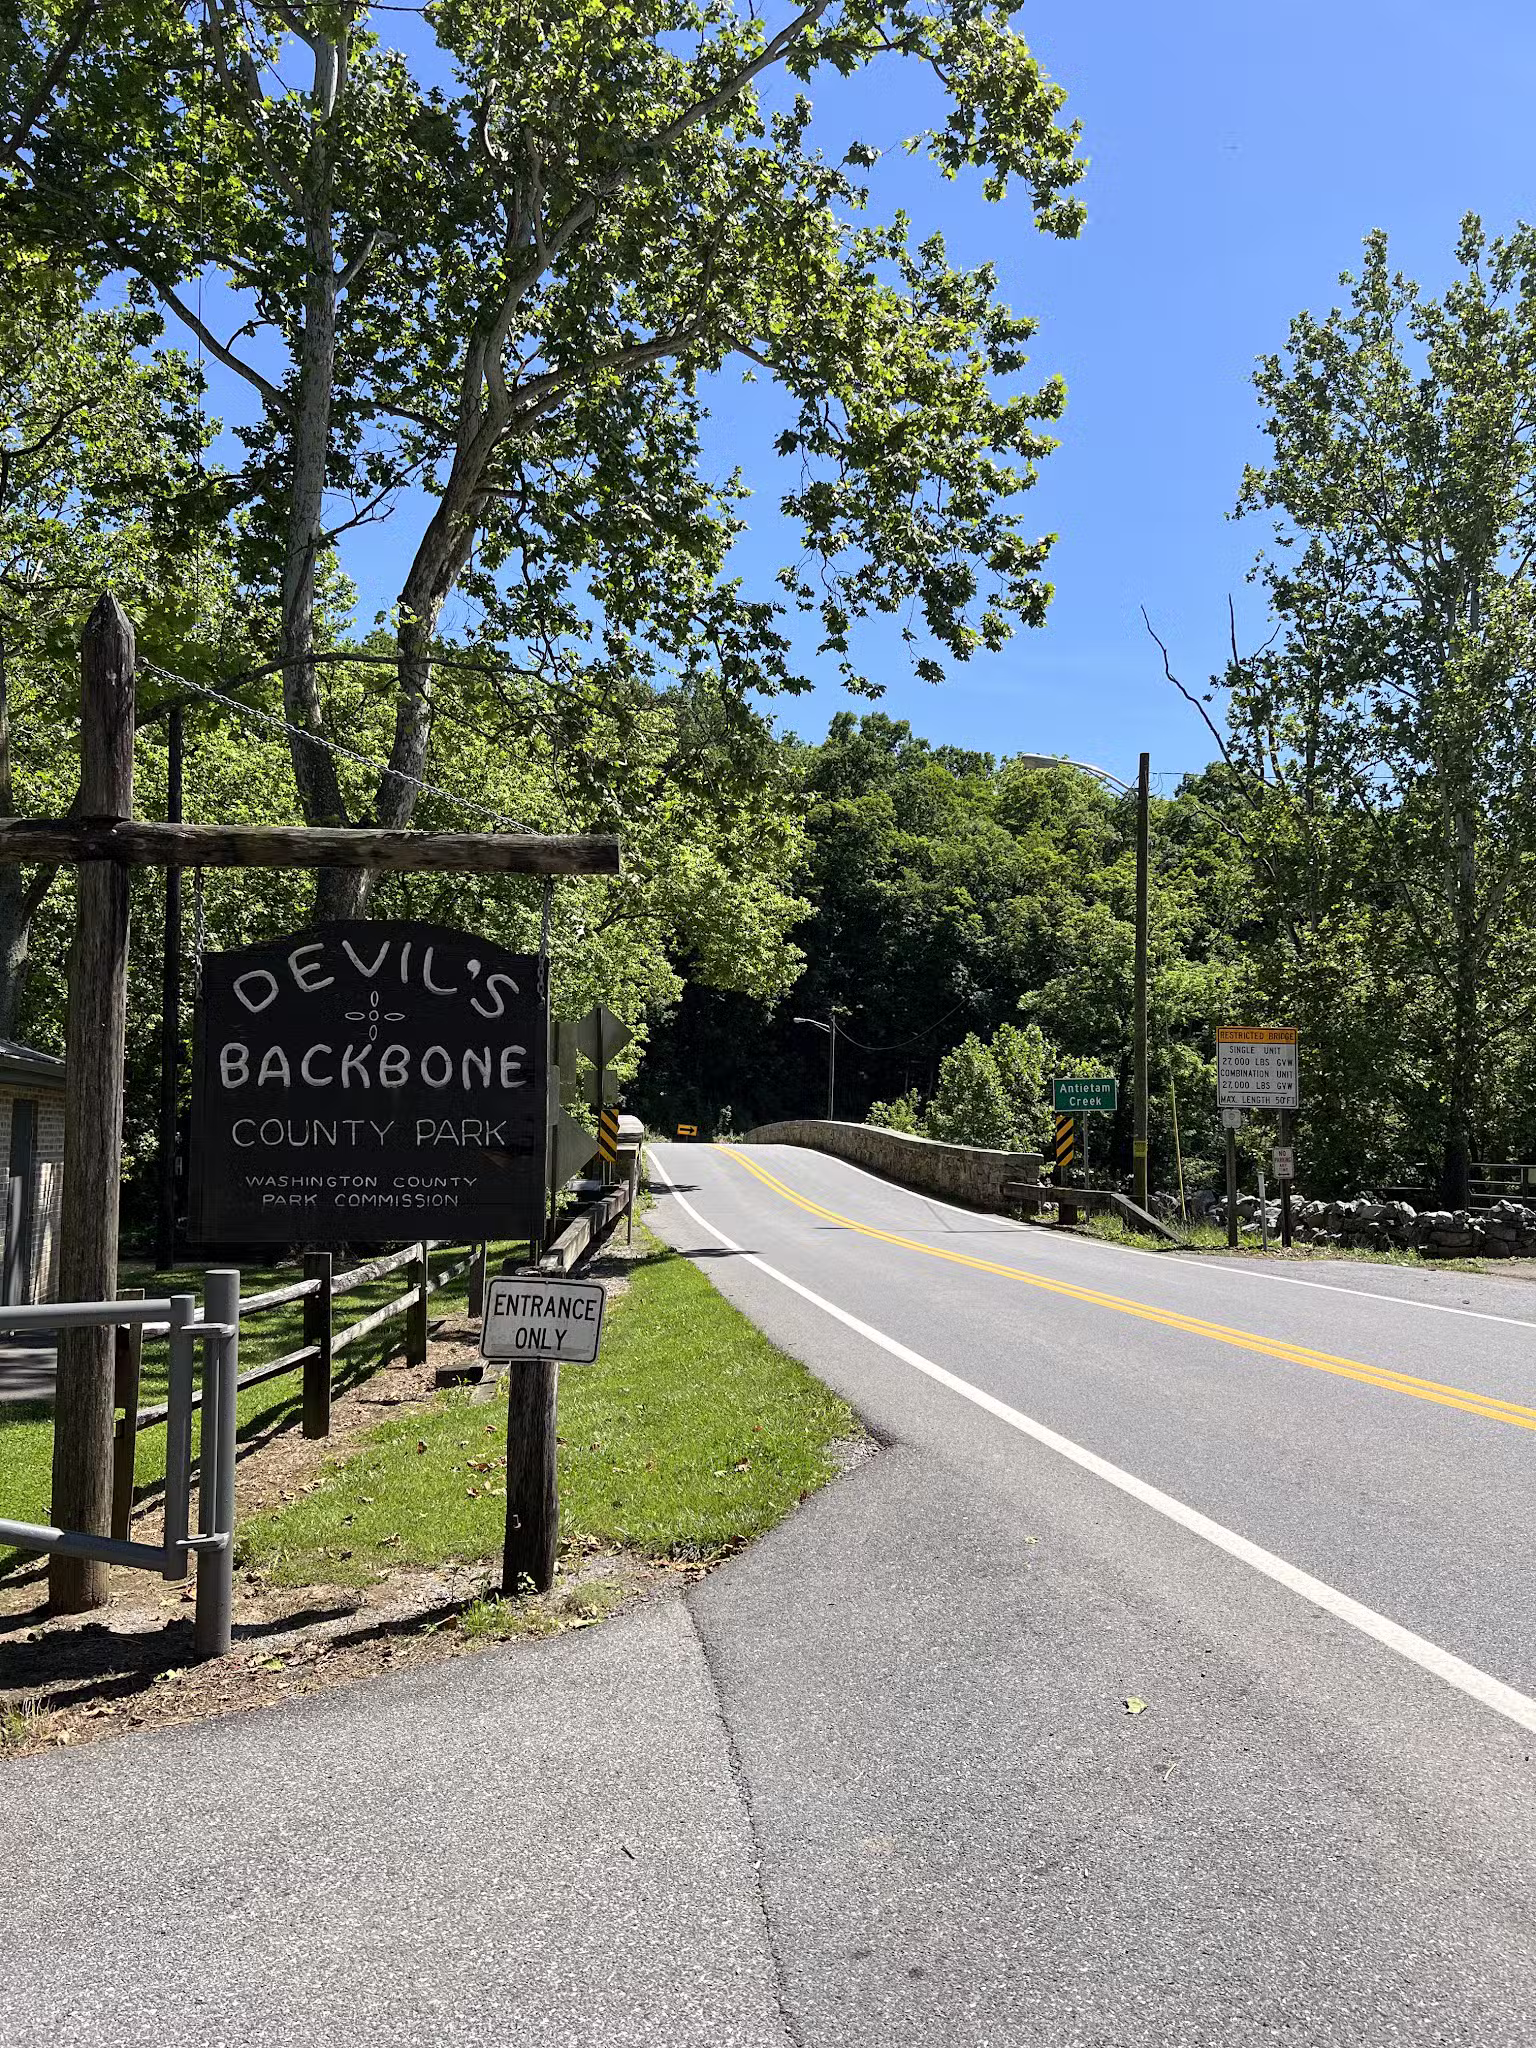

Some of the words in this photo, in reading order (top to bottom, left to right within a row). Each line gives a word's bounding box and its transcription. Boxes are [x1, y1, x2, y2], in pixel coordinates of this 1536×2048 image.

[233, 941, 519, 1018] DEVIL'S
[1220, 1031, 1265, 1040] RESTRICTED
[1268, 1033, 1294, 1041] BRIDGE
[1229, 1046, 1256, 1055] SINGLE
[1264, 1047, 1281, 1055] UNIT
[220, 1043, 527, 1090] BACKBONE
[1255, 1058, 1270, 1067] LBS
[1276, 1059, 1293, 1067] GVW
[1220, 1069, 1270, 1078] COMBINATION
[1276, 1070, 1293, 1079] UNIT
[1060, 1084, 1110, 1093] Antietam
[1222, 1080, 1250, 1090] 27,000
[1256, 1081, 1271, 1090] LBS
[1276, 1082, 1293, 1090] GVW
[1069, 1097, 1101, 1106] Creek
[1242, 1095, 1271, 1104] LENGTH
[232, 1119, 394, 1147] COUNTY
[416, 1119, 507, 1147] PARK
[245, 1176, 377, 1188] WASHINGTON
[393, 1176, 477, 1188] COUNTY
[262, 1194, 318, 1207] PARK
[334, 1194, 458, 1208] COMMISSION
[494, 1293, 597, 1321] ENTRANCE
[515, 1327, 568, 1351] ONLY
